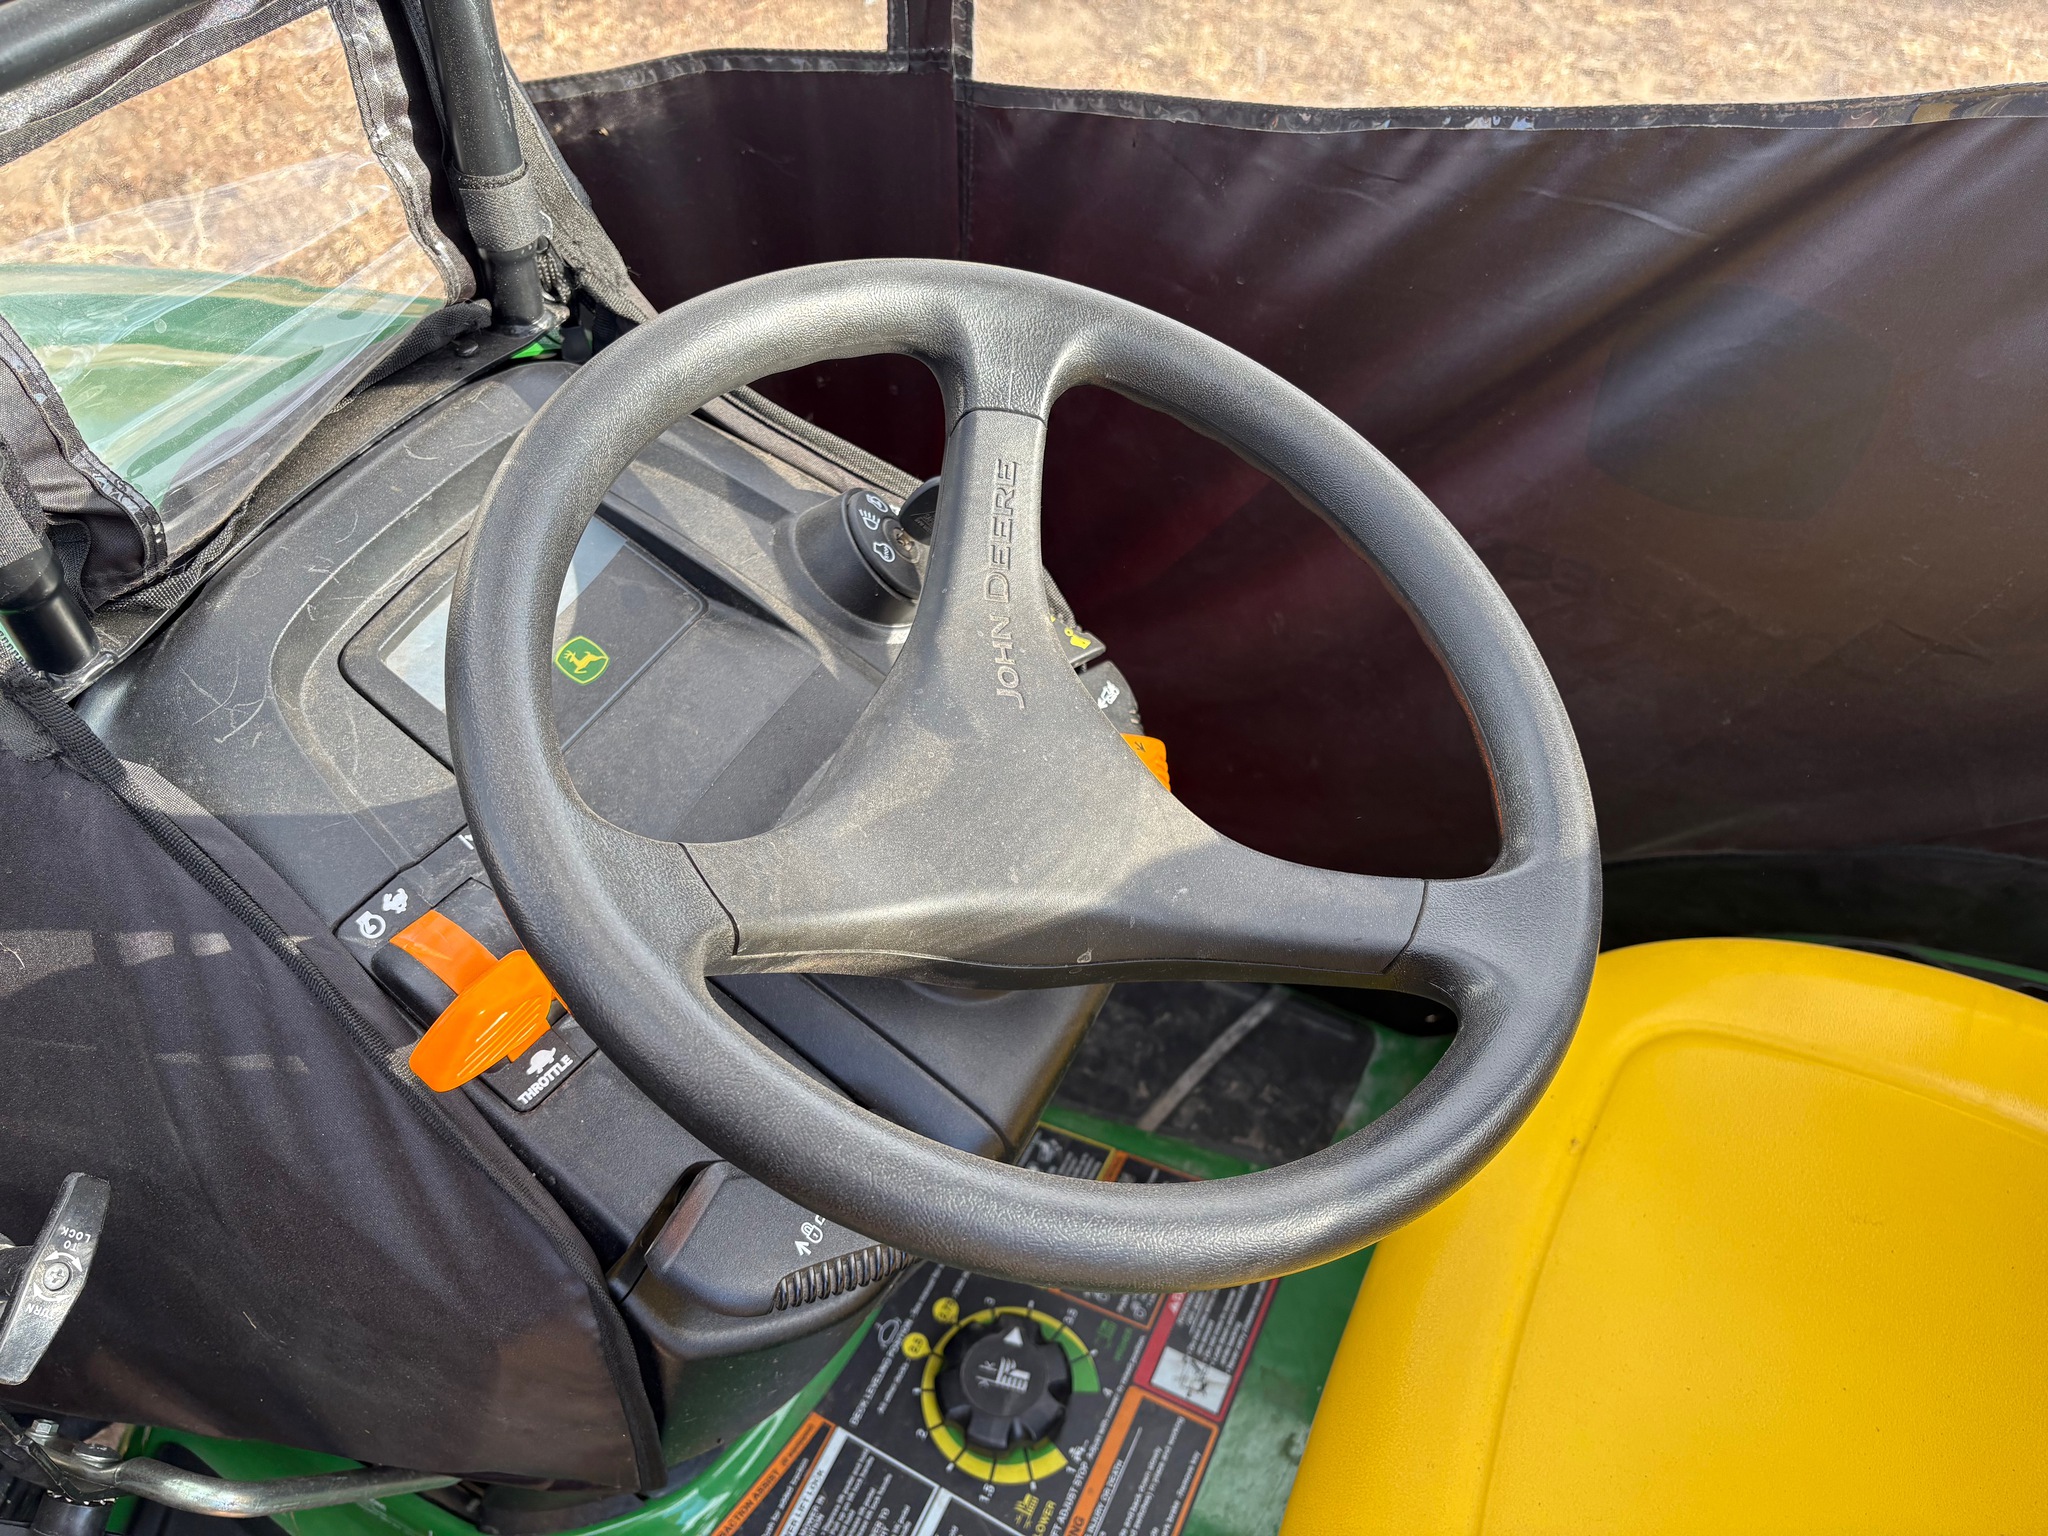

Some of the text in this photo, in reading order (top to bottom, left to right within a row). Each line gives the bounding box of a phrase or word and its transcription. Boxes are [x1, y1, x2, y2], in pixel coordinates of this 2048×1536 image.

[986, 457, 1026, 710] JOHN DEERE
[517, 1054, 574, 1104] THROTTLE
[60, 1226, 91, 1243] LOCK
[63, 1241, 79, 1252] TO
[25, 1302, 53, 1320] TURN
[984, 1295, 997, 1306] 3
[863, 1355, 891, 1399] LEVELING
[1101, 1386, 1114, 1399] 4
[914, 1427, 928, 1440] 2
[794, 1497, 809, 1517] LIFT
[805, 1468, 824, 1495] LOCK
[977, 1482, 995, 1504] 1.5
[1055, 1486, 1079, 1524] ADJUST
[1072, 1460, 1090, 1487] STOP
[1085, 1458, 1123, 1533] INJURY OR DEATH
[1032, 1499, 1056, 1536] LOWER
